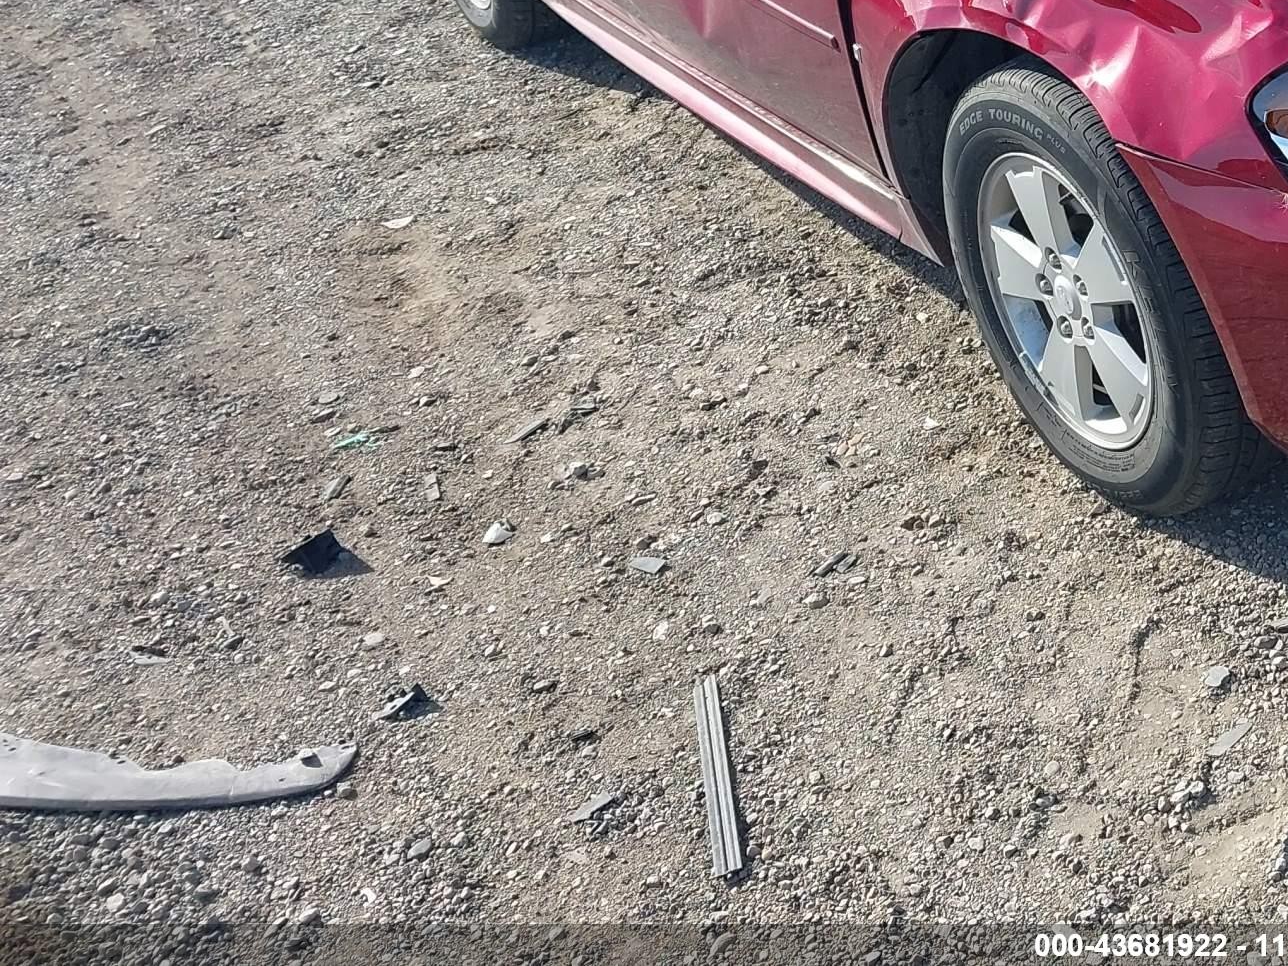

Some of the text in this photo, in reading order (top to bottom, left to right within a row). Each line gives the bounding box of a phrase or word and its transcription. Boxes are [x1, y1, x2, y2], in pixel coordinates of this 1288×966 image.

[960, 108, 1066, 154] EDGE TOURING PLUS
